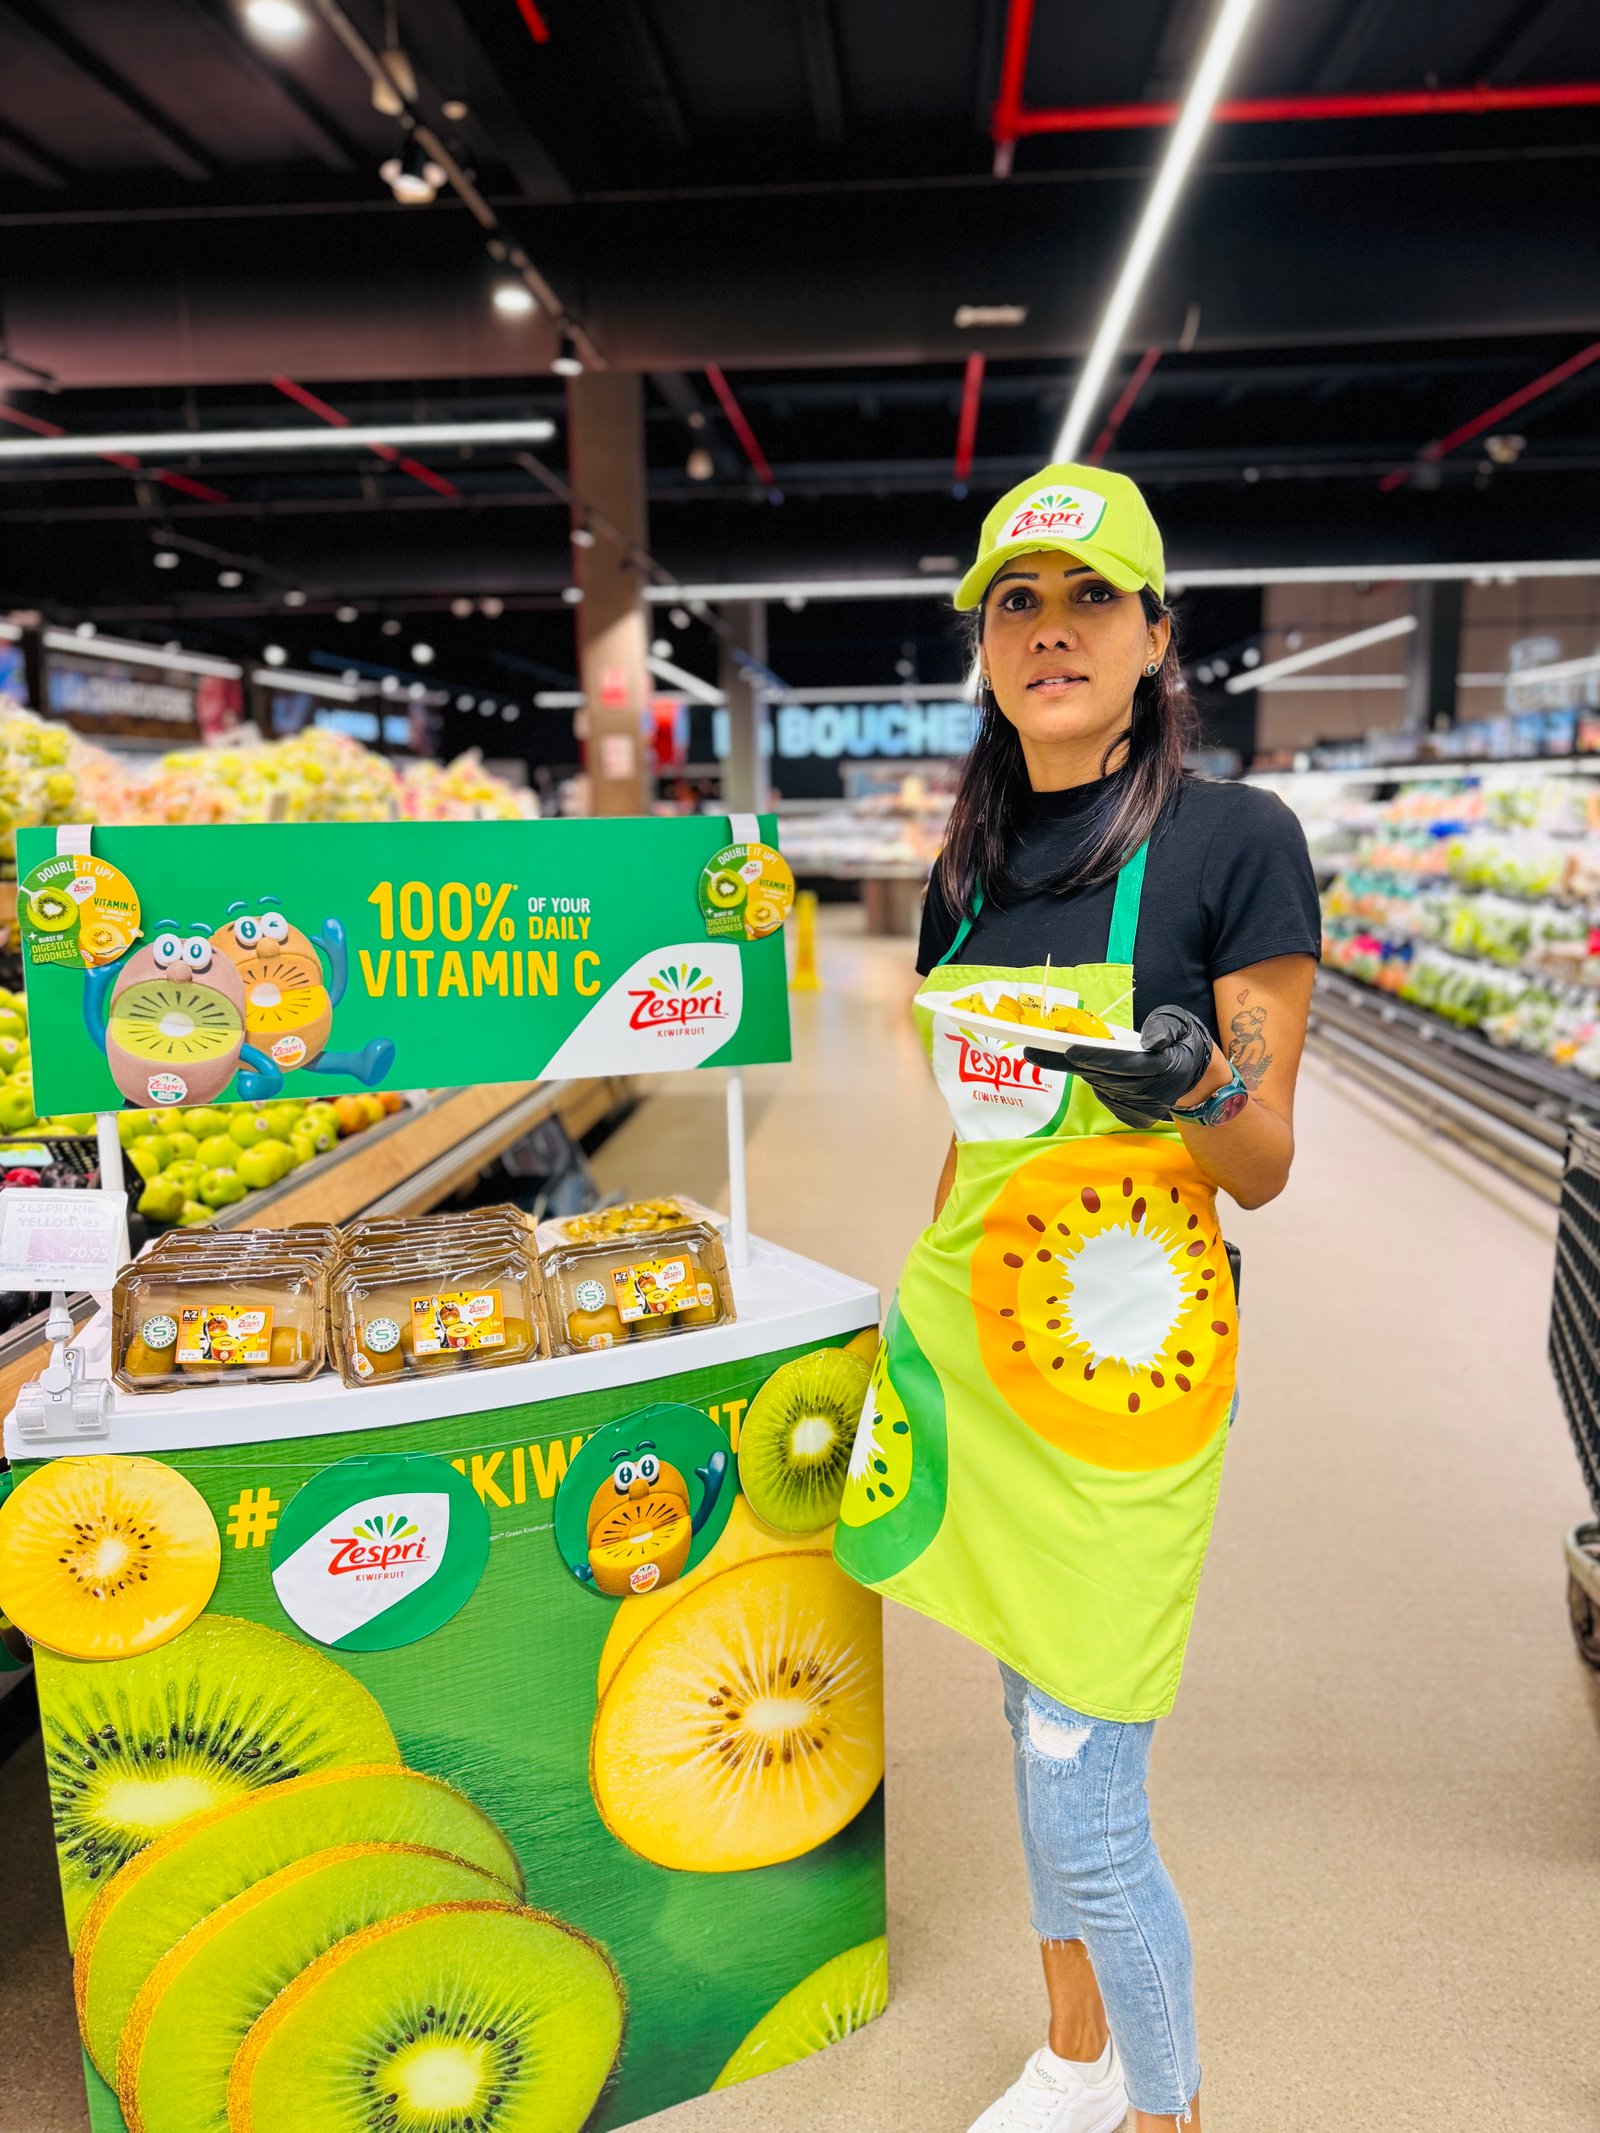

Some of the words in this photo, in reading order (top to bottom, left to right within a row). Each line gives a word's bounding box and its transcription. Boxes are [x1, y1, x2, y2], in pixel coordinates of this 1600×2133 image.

[1011, 510, 1085, 537] Zespri
[777, 702, 980, 757] BOUCHE
[717, 846, 751, 865] DOUBLE
[753, 847, 762, 857] IT
[762, 851, 778, 865] UP!
[37, 860, 79, 883] DOUBLE
[82, 861, 93, 872] IT
[94, 863, 115, 881] UP!
[759, 878, 785, 890] VITAMIN
[786, 883, 792, 891] C
[93, 897, 129, 911] VITAMIN
[131, 903, 137, 912] C
[527, 897, 547, 913] OF
[550, 897, 591, 914] YOUR
[528, 916, 591, 940] DAILY
[707, 915, 741, 927] DIGESTIVE
[707, 923, 743, 935] GOODNESS
[31, 940, 75, 954] DIGESTIVE
[32, 949, 78, 963] GOODNESS
[358, 949, 559, 998] VITAMIN
[573, 949, 601, 998] C
[627, 990, 727, 1031] Zespri
[657, 1027, 705, 1038] KIWIFRUIT
[150, 1078, 184, 1091] Zespri
[972, 1090, 1024, 1108] KIWIFRUIT
[17, 1203, 67, 1214] ZESPRI
[68, 1247, 109, 1259] 70.95
[450, 1434, 592, 1508] KIW
[327, 1536, 427, 1576] Zespri
[355, 1570, 405, 1582] KIWIFRUIT
